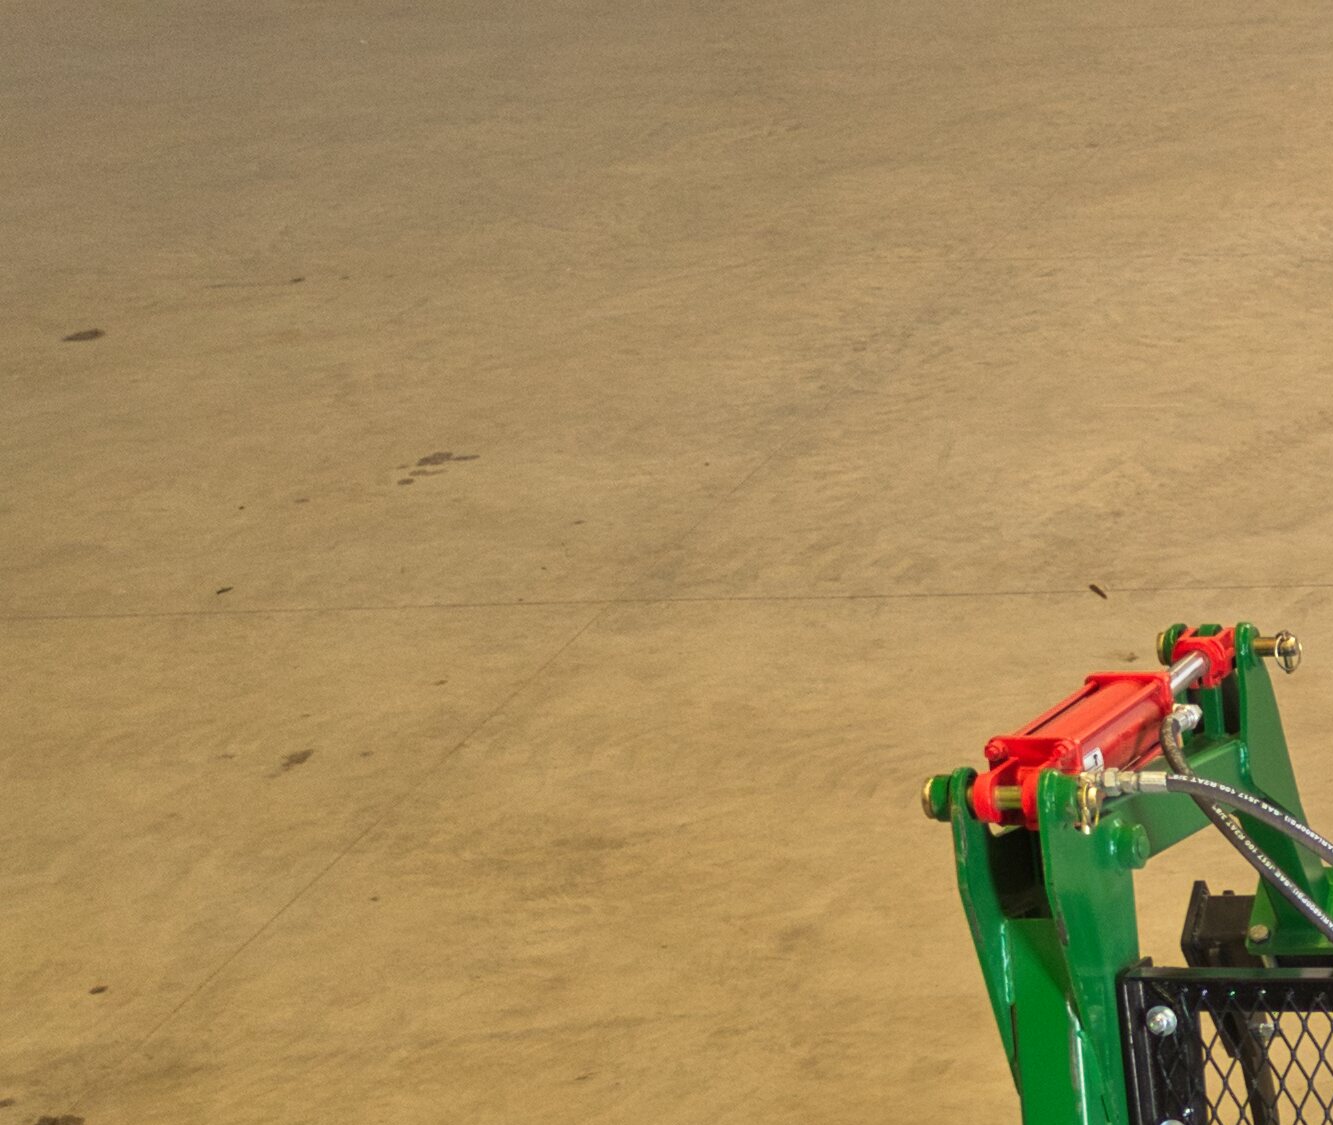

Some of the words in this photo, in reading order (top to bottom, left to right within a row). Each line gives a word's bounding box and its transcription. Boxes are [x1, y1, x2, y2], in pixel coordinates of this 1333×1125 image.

[1190, 776, 1217, 788] R2AT
[1220, 785, 1236, 795] 100
[1238, 793, 1260, 804] J517
[1225, 820, 1246, 841] R2AT
[1244, 840, 1258, 854] 100
[1257, 854, 1276, 871] J517
